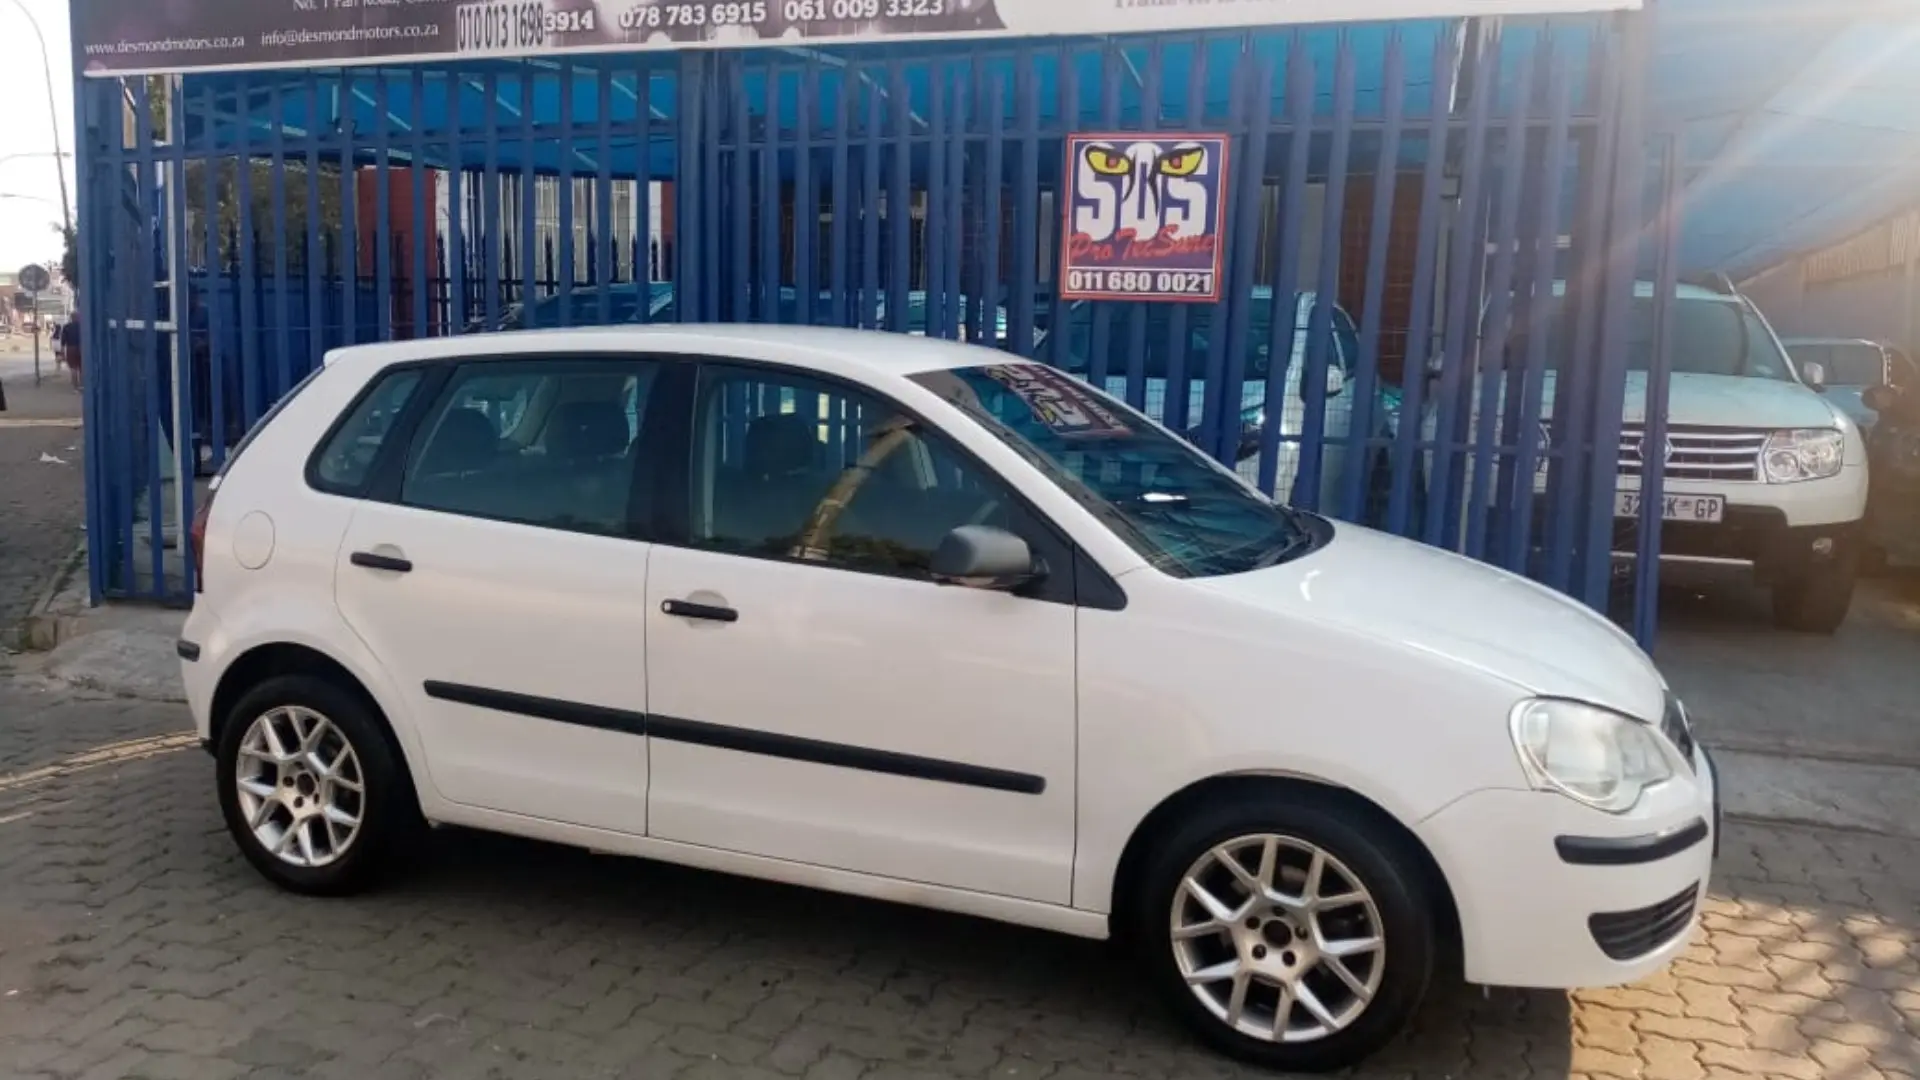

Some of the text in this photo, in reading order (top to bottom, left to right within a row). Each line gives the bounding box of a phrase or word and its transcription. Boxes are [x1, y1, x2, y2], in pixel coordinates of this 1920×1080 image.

[458, 2, 543, 51] 010 013 1698
[544, 0, 944, 32] 3914 078 783 6915 061 009 3323
[84, 36, 245, 55] www.desmondmotors.co.za
[260, 24, 440, 46] info@desmondmotors.co.za
[1069, 271, 1212, 294] 011 680 0021
[1694, 498, 1718, 519] GP
